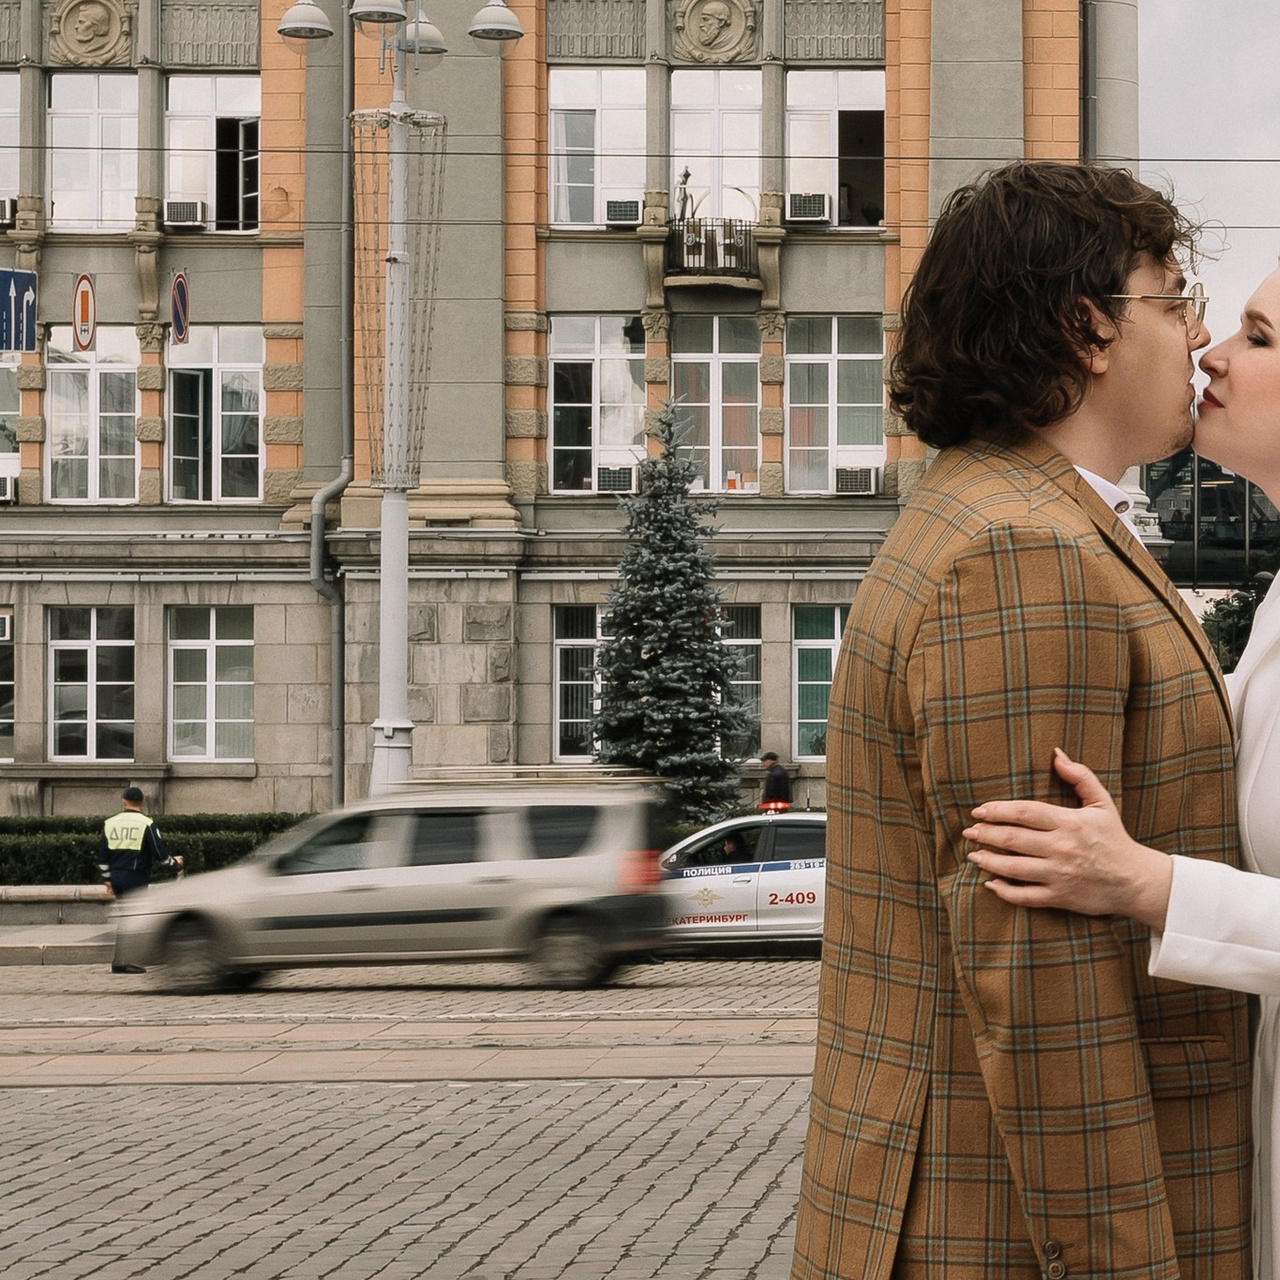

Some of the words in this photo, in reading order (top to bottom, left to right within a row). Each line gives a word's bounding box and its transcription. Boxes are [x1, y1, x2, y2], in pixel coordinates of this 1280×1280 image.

[110, 826, 140, 841] ДПС
[683, 866, 732, 877] ПОЛИЦИЯ
[768, 891, 817, 906] 2-409
[665, 914, 748, 926] ЕКАТЕРИНБУРГ
